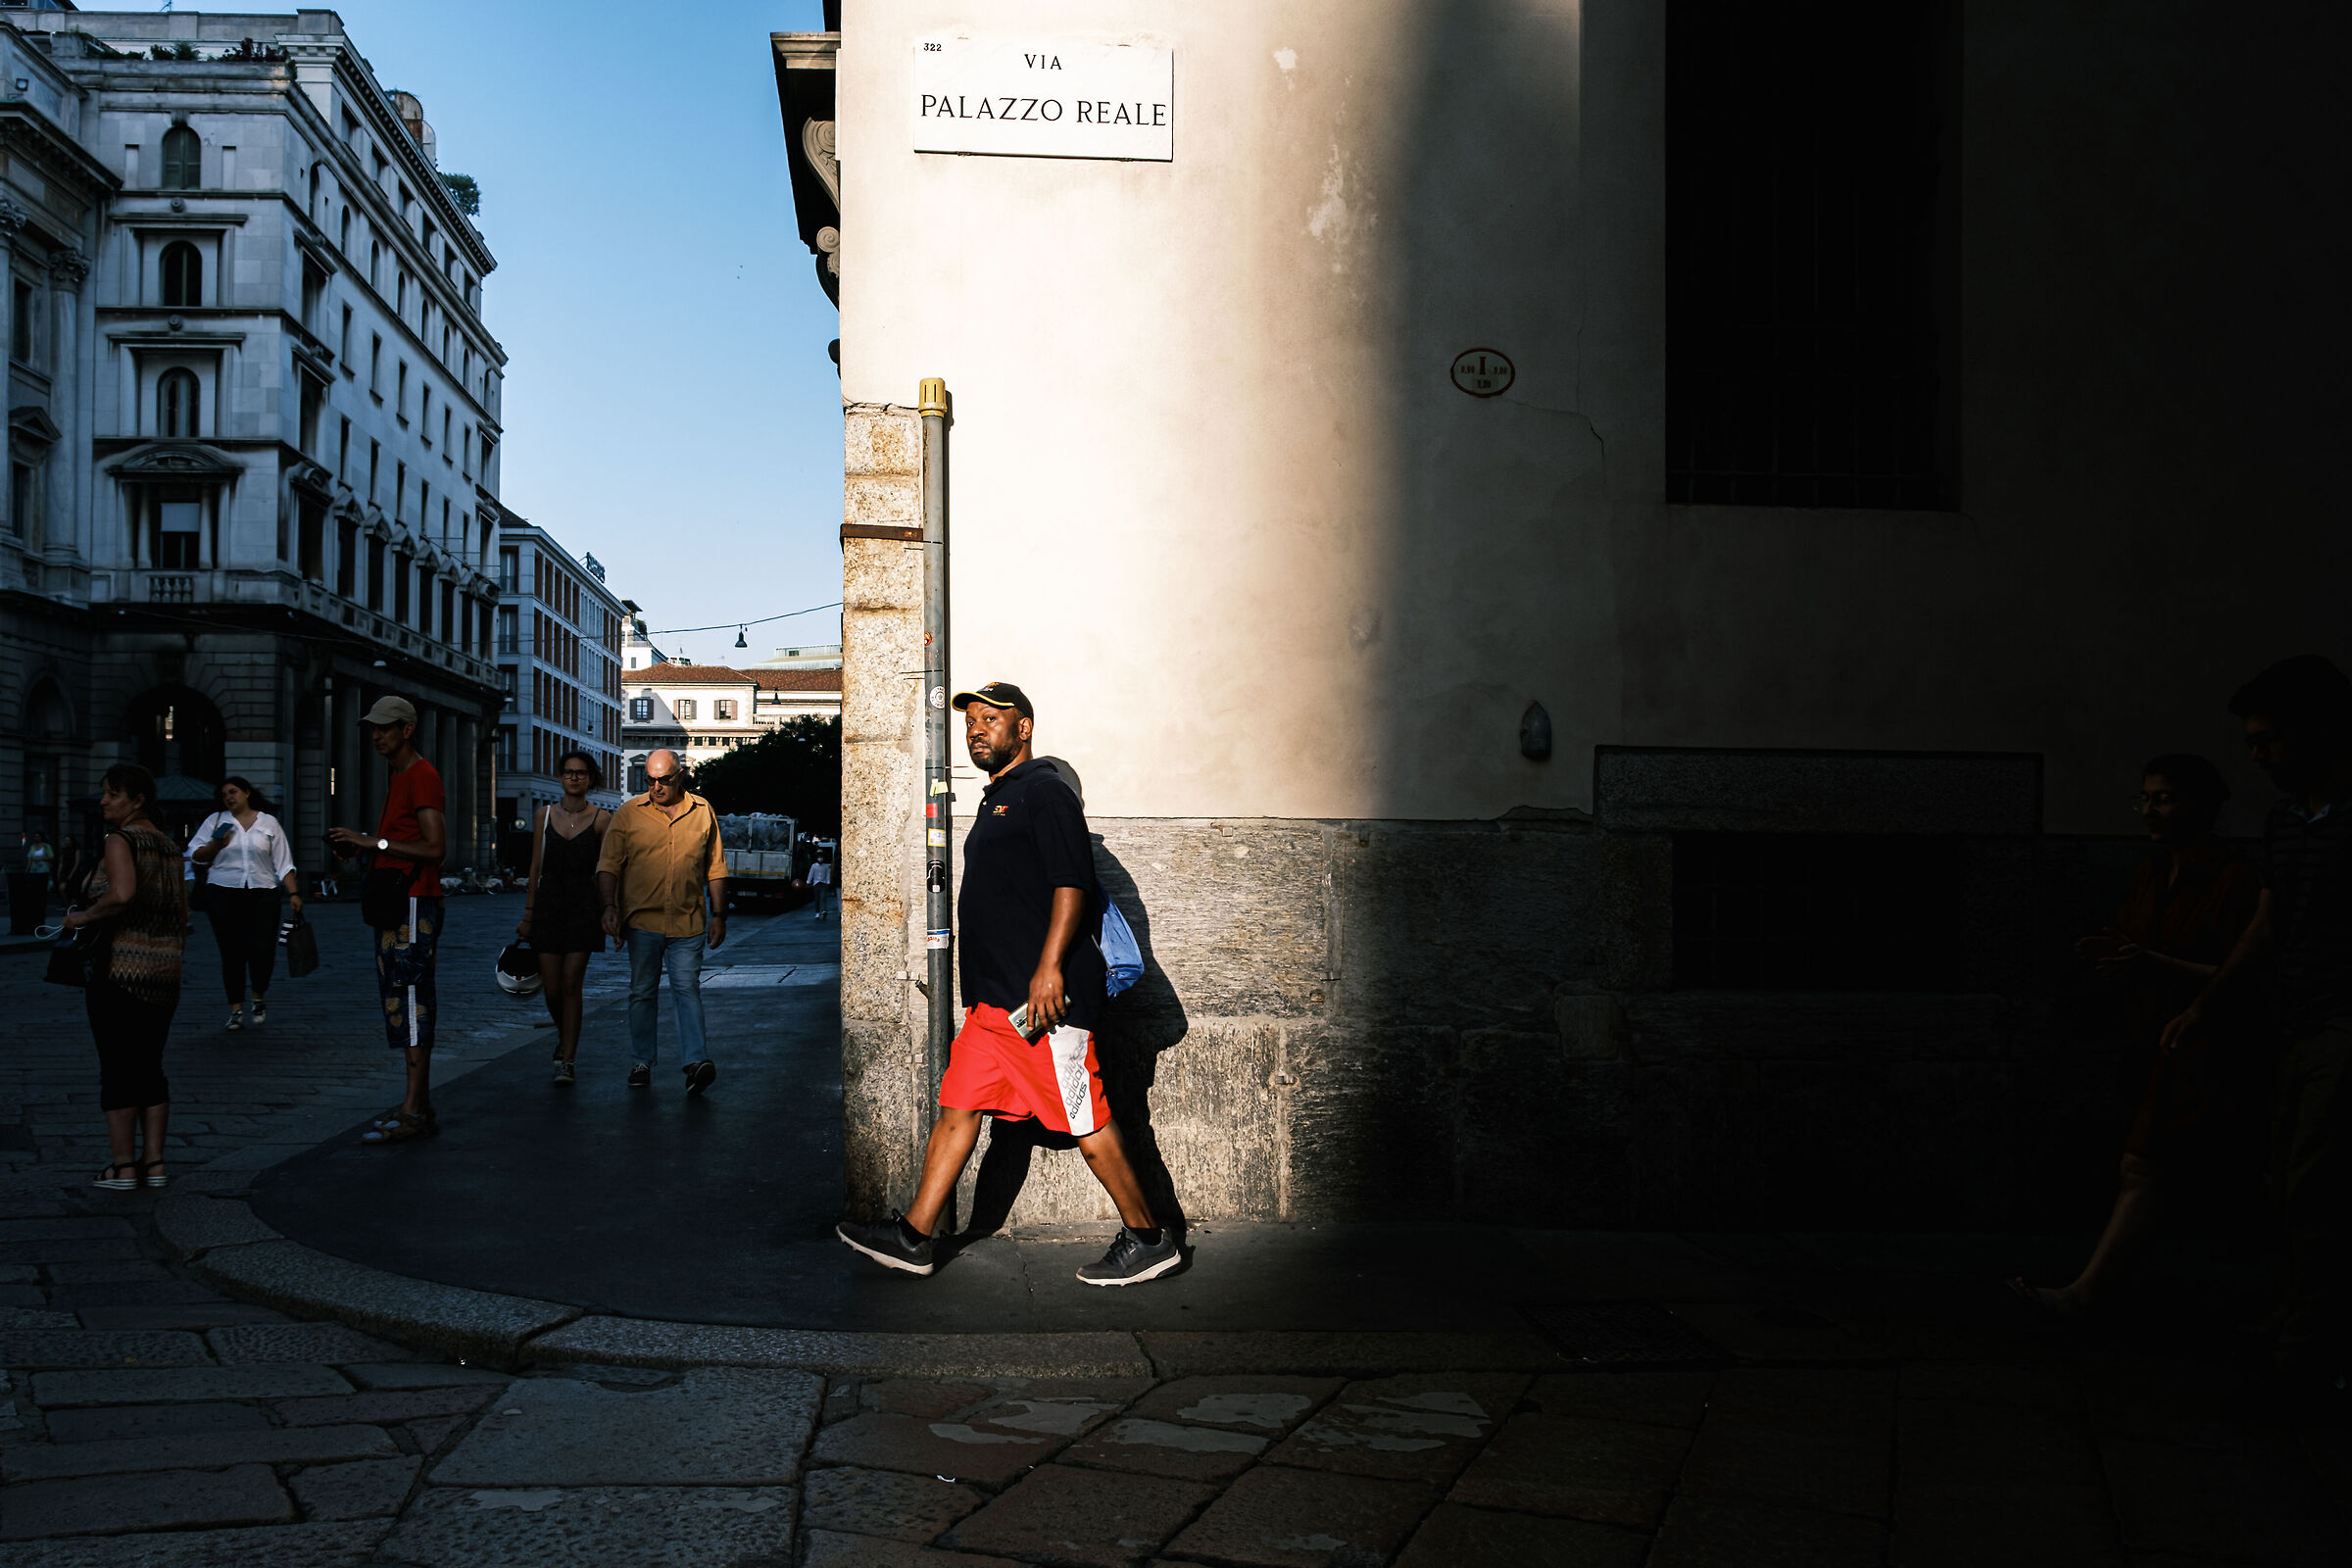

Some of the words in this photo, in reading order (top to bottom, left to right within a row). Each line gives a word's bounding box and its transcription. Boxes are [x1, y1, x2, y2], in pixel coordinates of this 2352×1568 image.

[923, 42, 942, 52] 322
[1024, 53, 1062, 71] VIA
[921, 94, 1063, 122] PALAZZO
[1076, 100, 1167, 126] REALE
[1069, 1082, 1087, 1119] adidas
